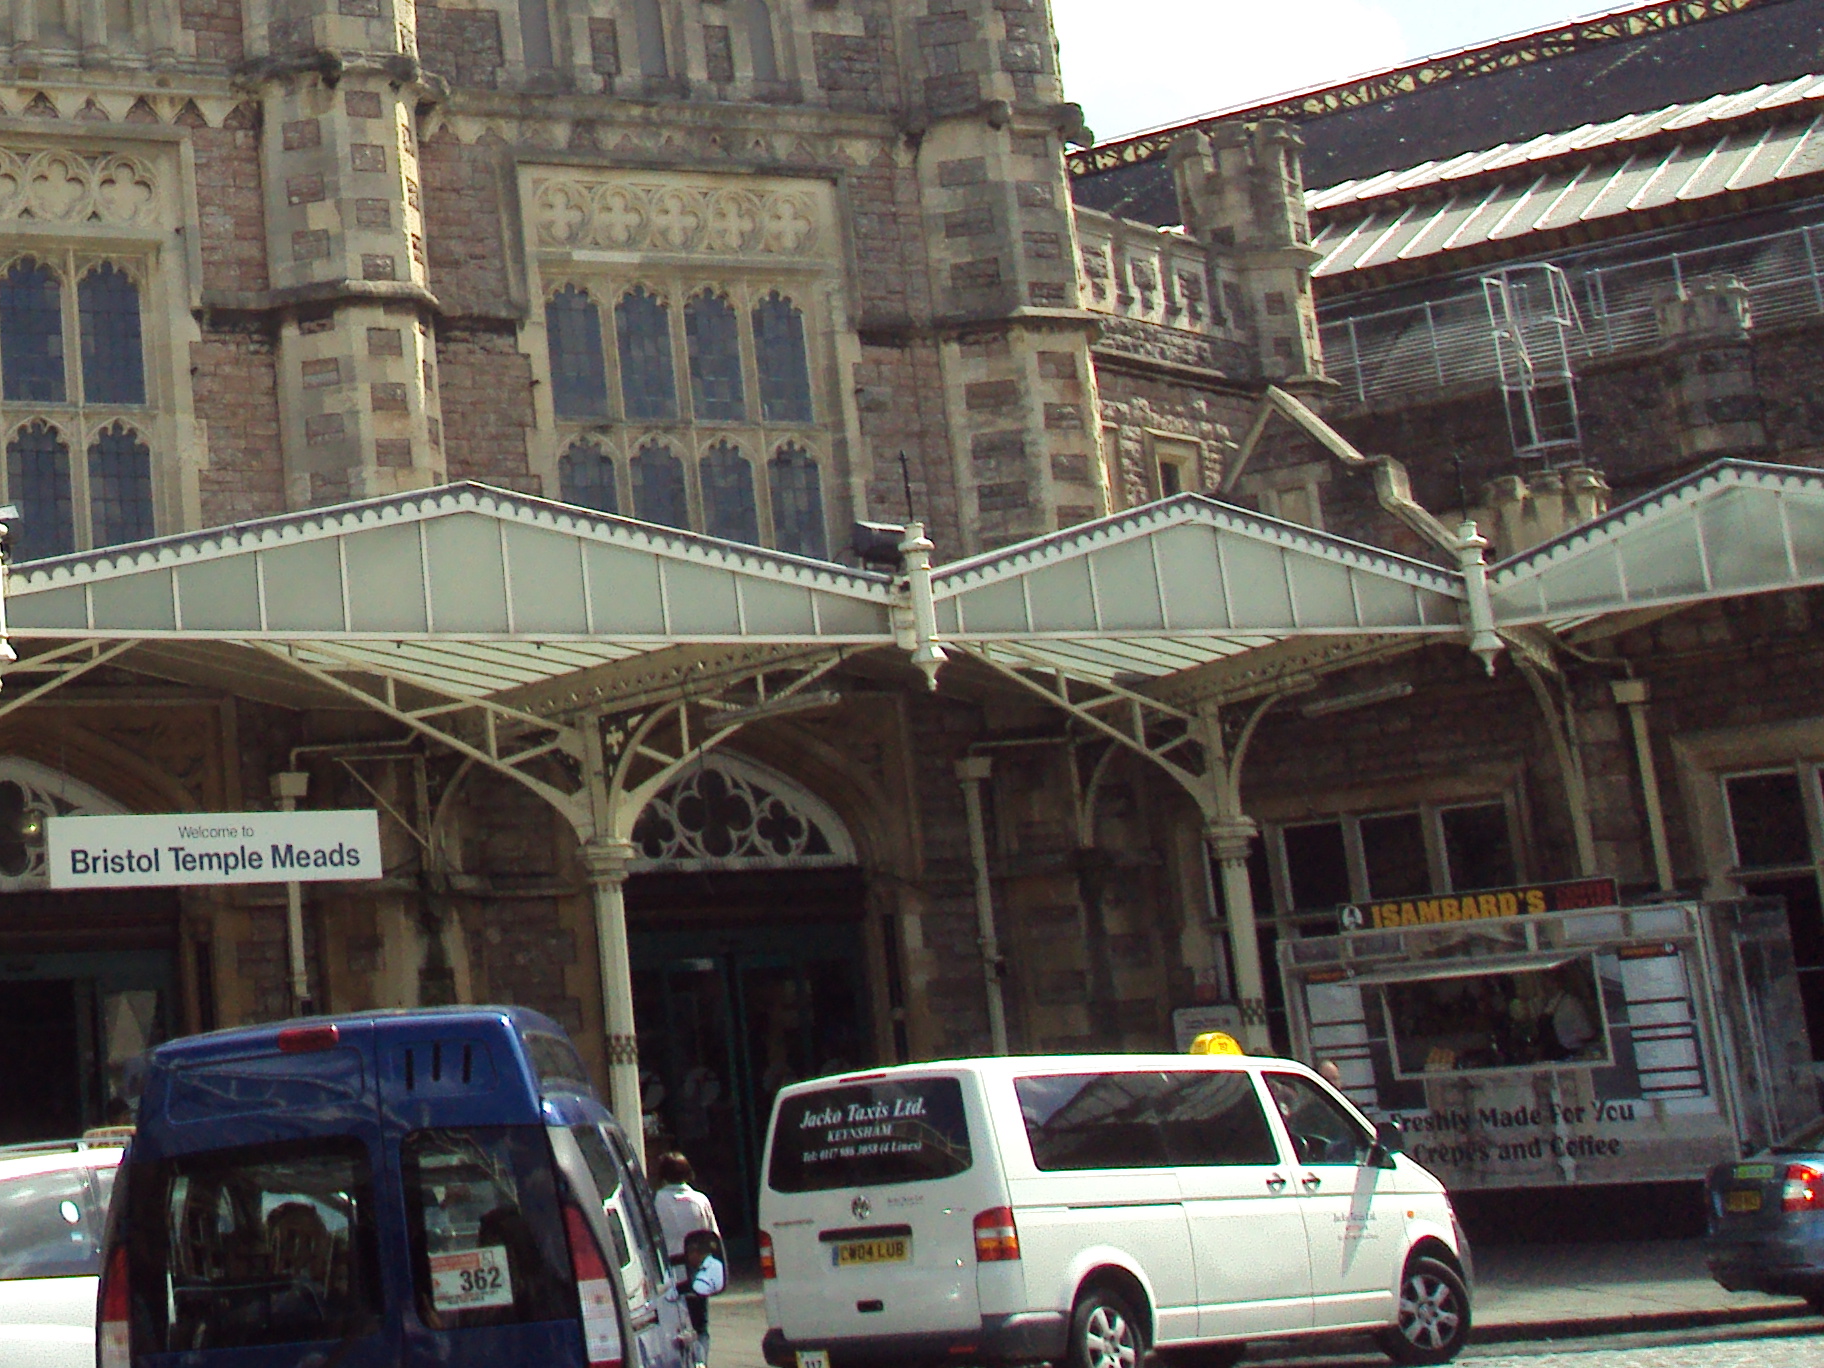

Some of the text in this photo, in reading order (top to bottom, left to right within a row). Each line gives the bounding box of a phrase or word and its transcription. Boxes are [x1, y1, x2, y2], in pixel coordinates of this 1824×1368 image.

[178, 825, 255, 839] Welcome to
[70, 843, 361, 875] Bristol Temple Meads
[1370, 889, 1547, 929] ISAMBARD'S
[799, 1096, 926, 1129] Jacko Taxis Ltd.
[1478, 1105, 1542, 1129] Made
[1549, 1103, 1585, 1125] For
[1590, 1099, 1635, 1123] You
[827, 1124, 892, 1142] KEYNSHAM
[1497, 1136, 1543, 1161] and
[1550, 1134, 1621, 1158] Coffee
[459, 1266, 502, 1292] 362
